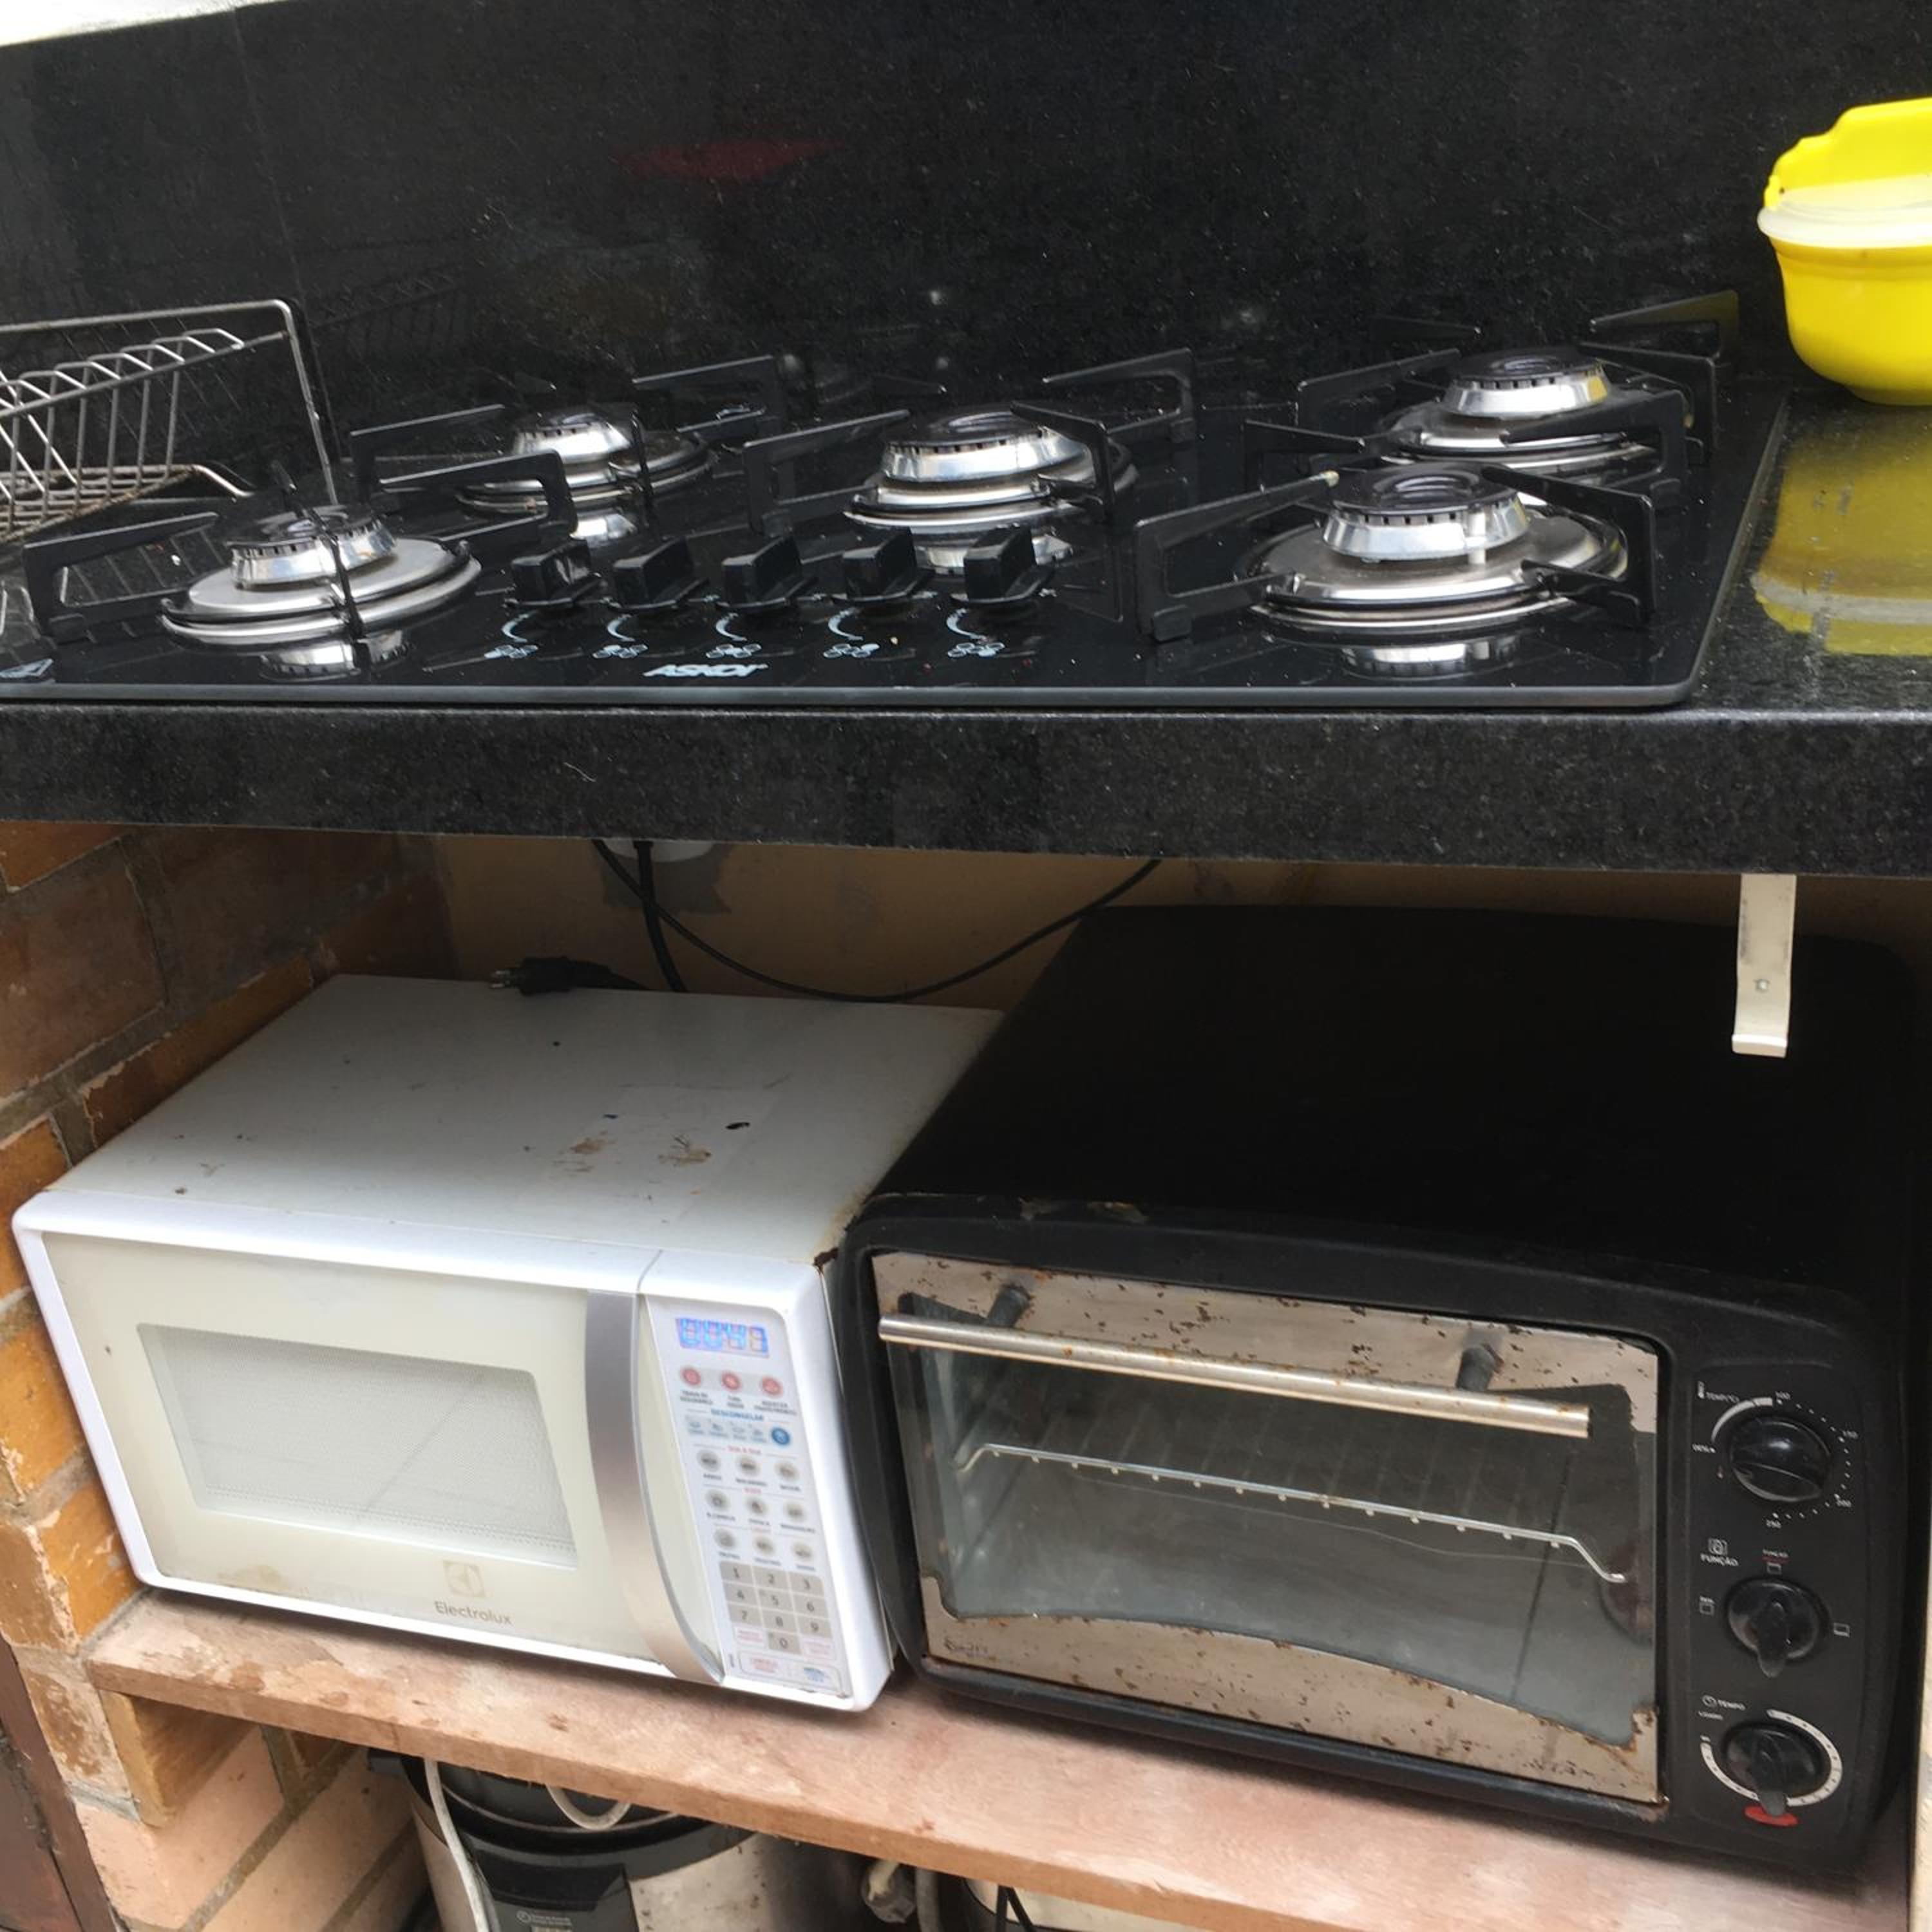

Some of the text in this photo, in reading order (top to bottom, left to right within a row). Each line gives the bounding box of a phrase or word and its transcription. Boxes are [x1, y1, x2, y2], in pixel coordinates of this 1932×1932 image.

[1700, 1553, 1739, 1566] FUNÇÃO
[734, 1566, 740, 1578] 1
[434, 1600, 513, 1624] Electrolux
[806, 1601, 815, 1612] 6
[810, 1622, 819, 1632] 9
[779, 1638, 788, 1649] 0
